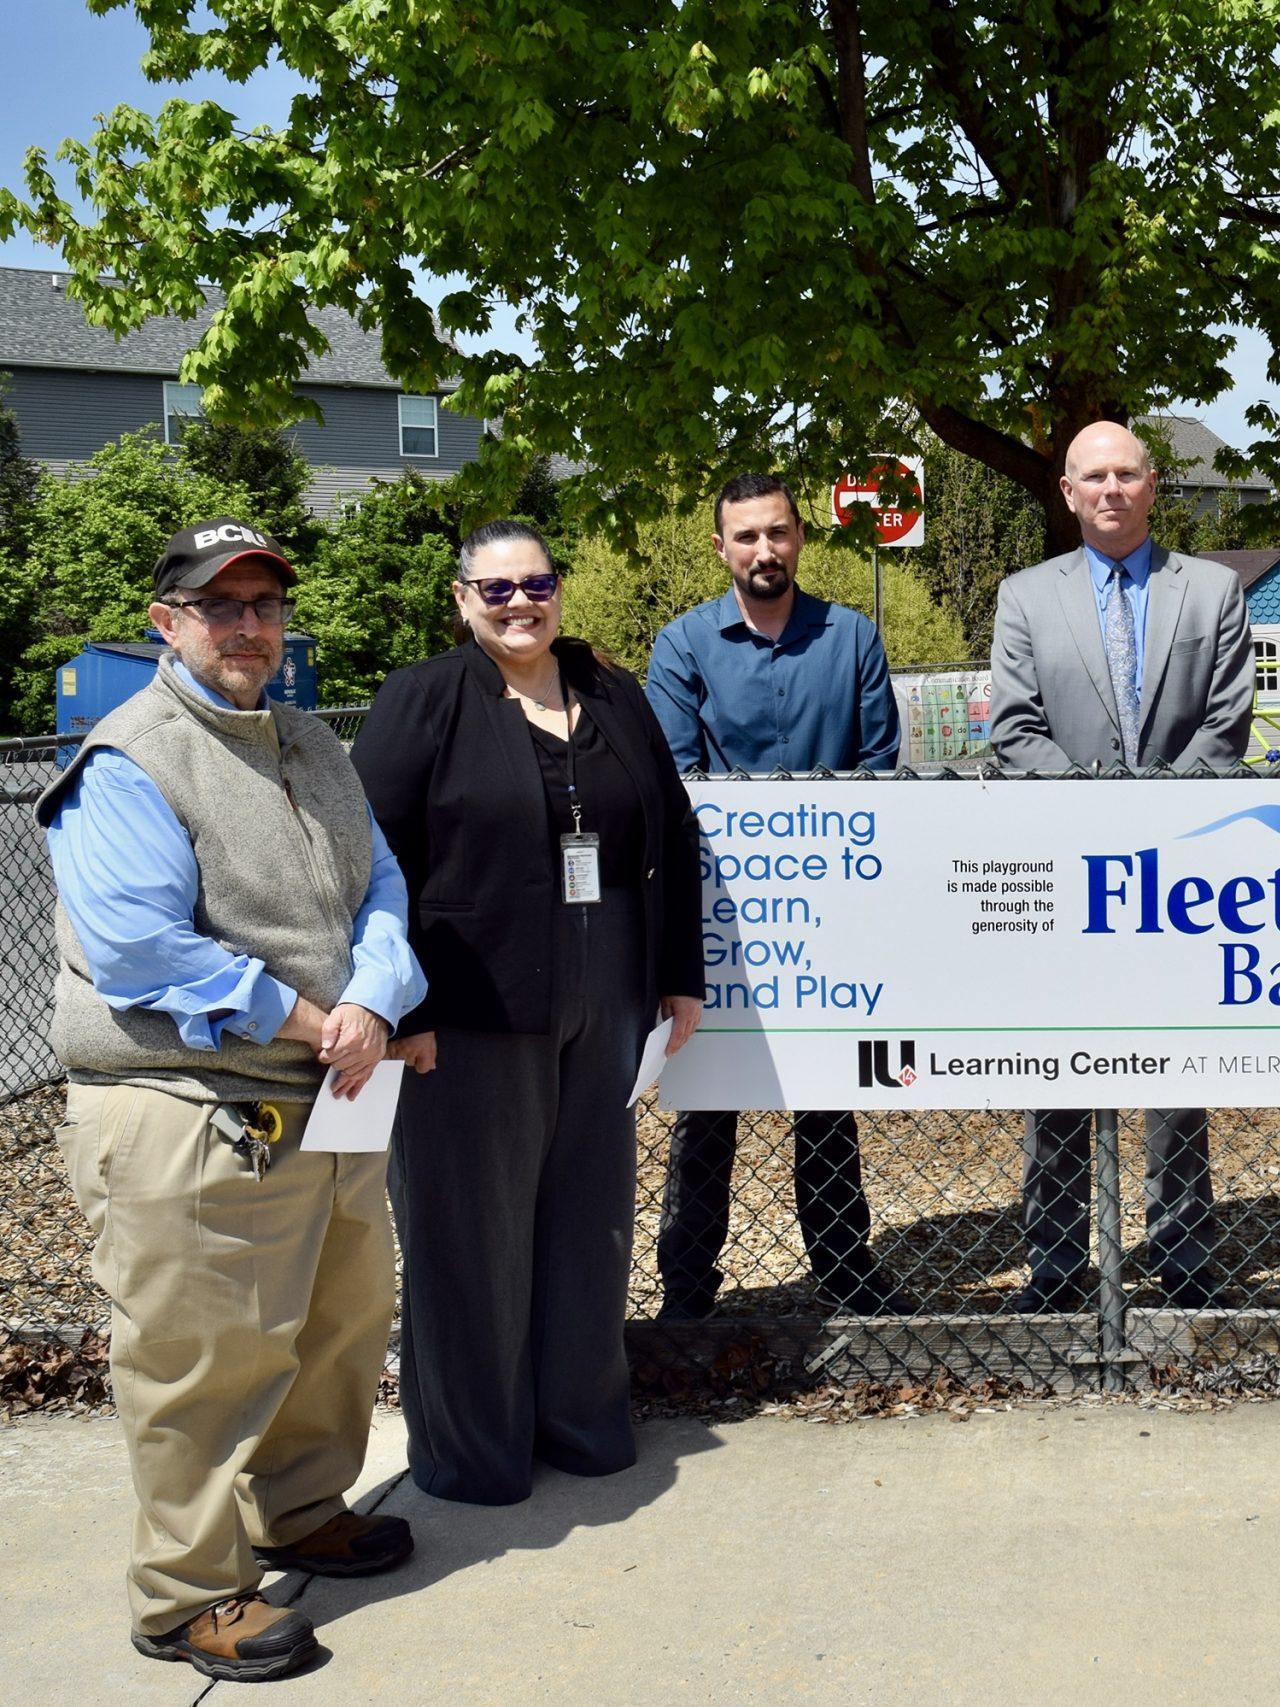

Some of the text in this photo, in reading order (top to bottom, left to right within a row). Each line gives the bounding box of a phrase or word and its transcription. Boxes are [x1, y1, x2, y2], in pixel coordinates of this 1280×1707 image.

[194, 524, 268, 549] BCIU
[693, 803, 877, 847] Creating
[699, 844, 883, 889] Space to
[951, 859, 1054, 876] This playground
[947, 879, 1054, 896] is made possible
[701, 896, 822, 929] earn,
[980, 899, 1054, 915] through the
[971, 918, 1055, 935] generosity of
[702, 932, 812, 971] Grow,
[703, 975, 884, 1016] and Play
[930, 1052, 1060, 1081] Learning
[1070, 1051, 1171, 1076] Center
[1181, 1056, 1208, 1074] AT
